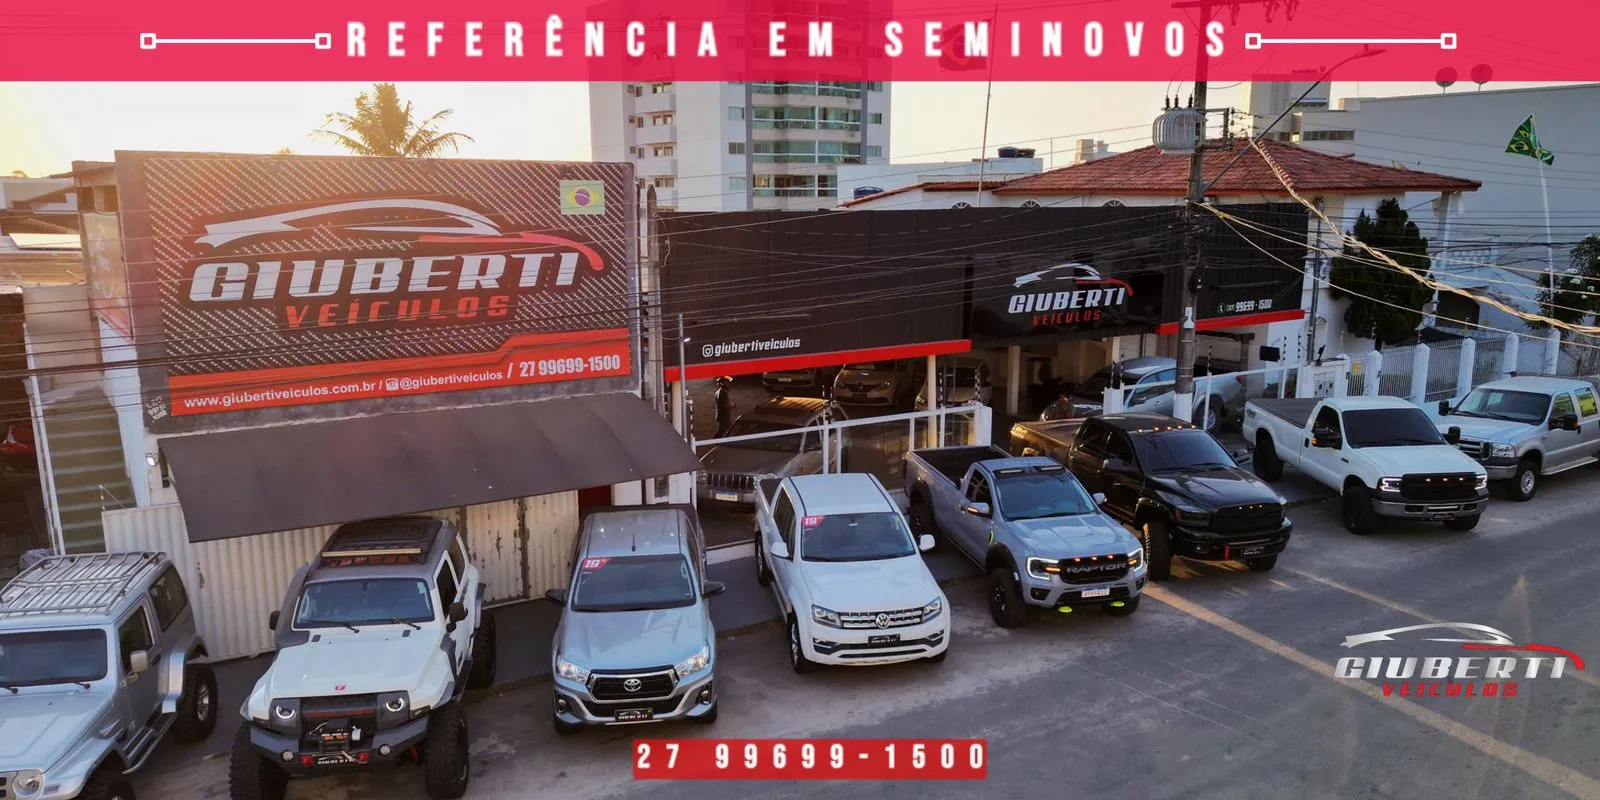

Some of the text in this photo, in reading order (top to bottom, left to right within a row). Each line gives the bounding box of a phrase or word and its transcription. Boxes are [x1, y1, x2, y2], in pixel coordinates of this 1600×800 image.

[189, 253, 579, 302] GIUBERTI
[286, 296, 509, 328] VEÍCULOS
[1008, 287, 1126, 314] GIUBERTI
[184, 380, 376, 408] www.giubertiveiculos.com.br
[400, 370, 503, 391] @giubertiveiculos
[519, 361, 535, 378] 27
[538, 355, 621, 376] 99699-1500
[1066, 562, 1127, 574] RAPTOR
